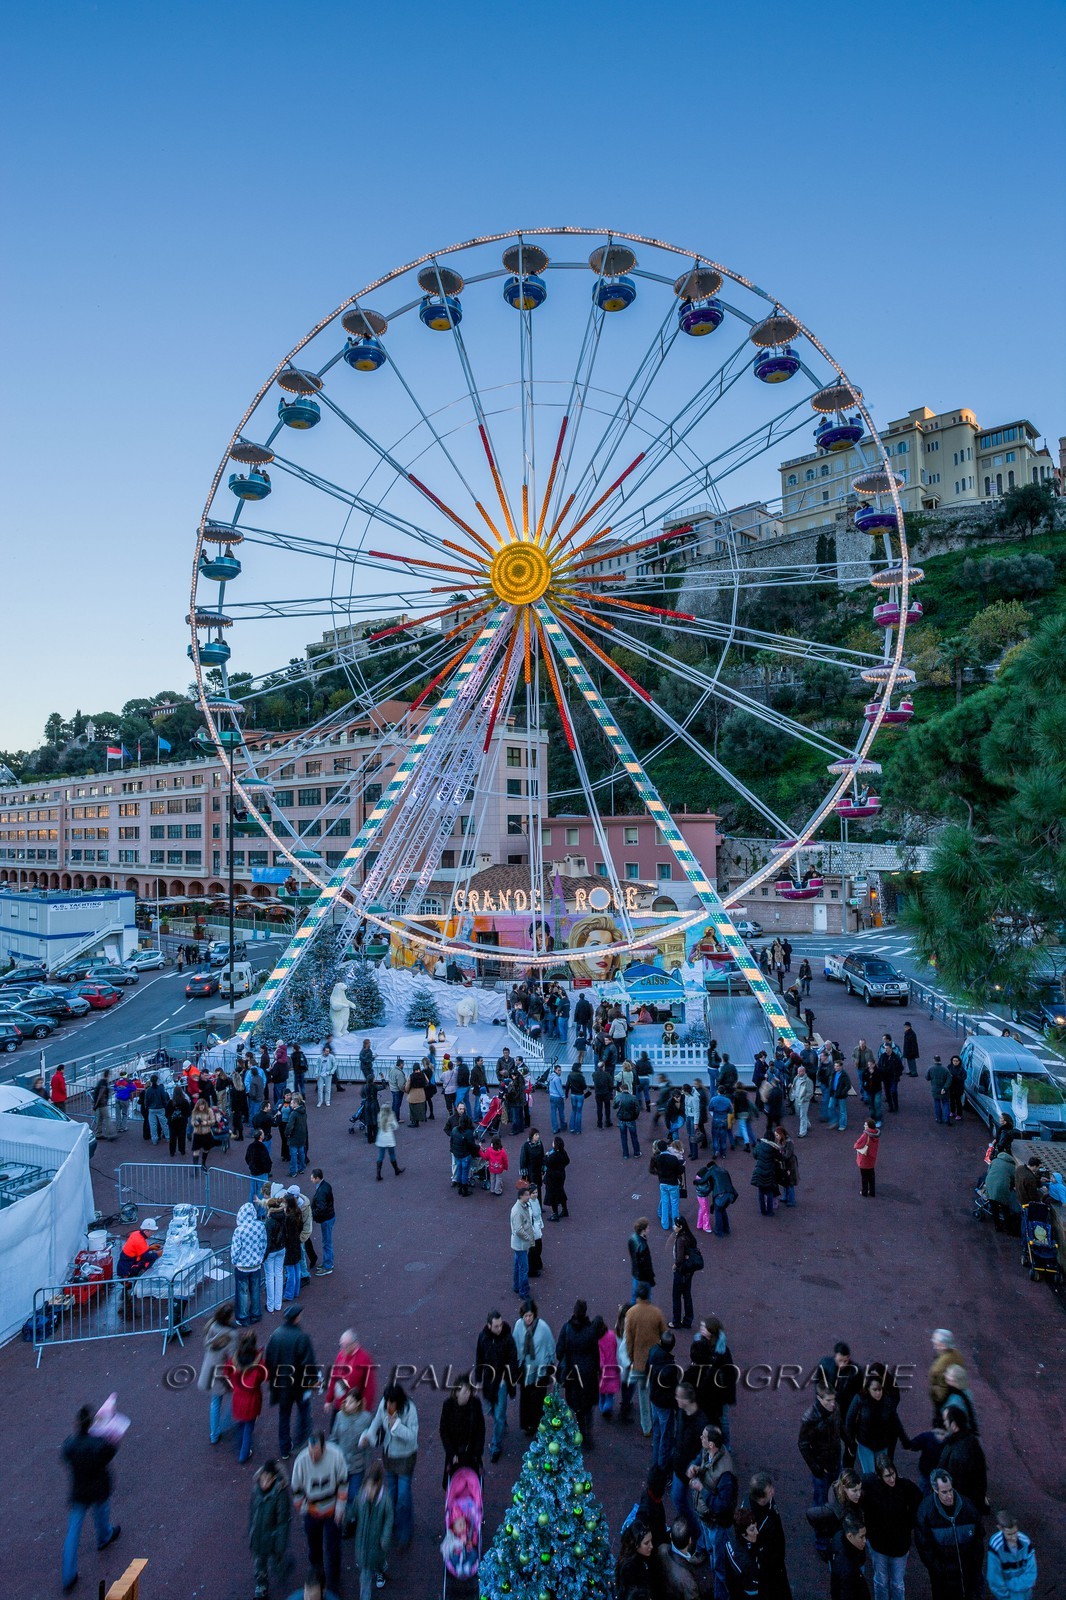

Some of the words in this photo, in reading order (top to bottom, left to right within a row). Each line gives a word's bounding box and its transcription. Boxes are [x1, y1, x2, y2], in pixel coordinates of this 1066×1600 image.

[454, 889, 541, 912] GRANDE
[575, 886, 638, 911] ROUE
[640, 975, 669, 986] CAISSE
